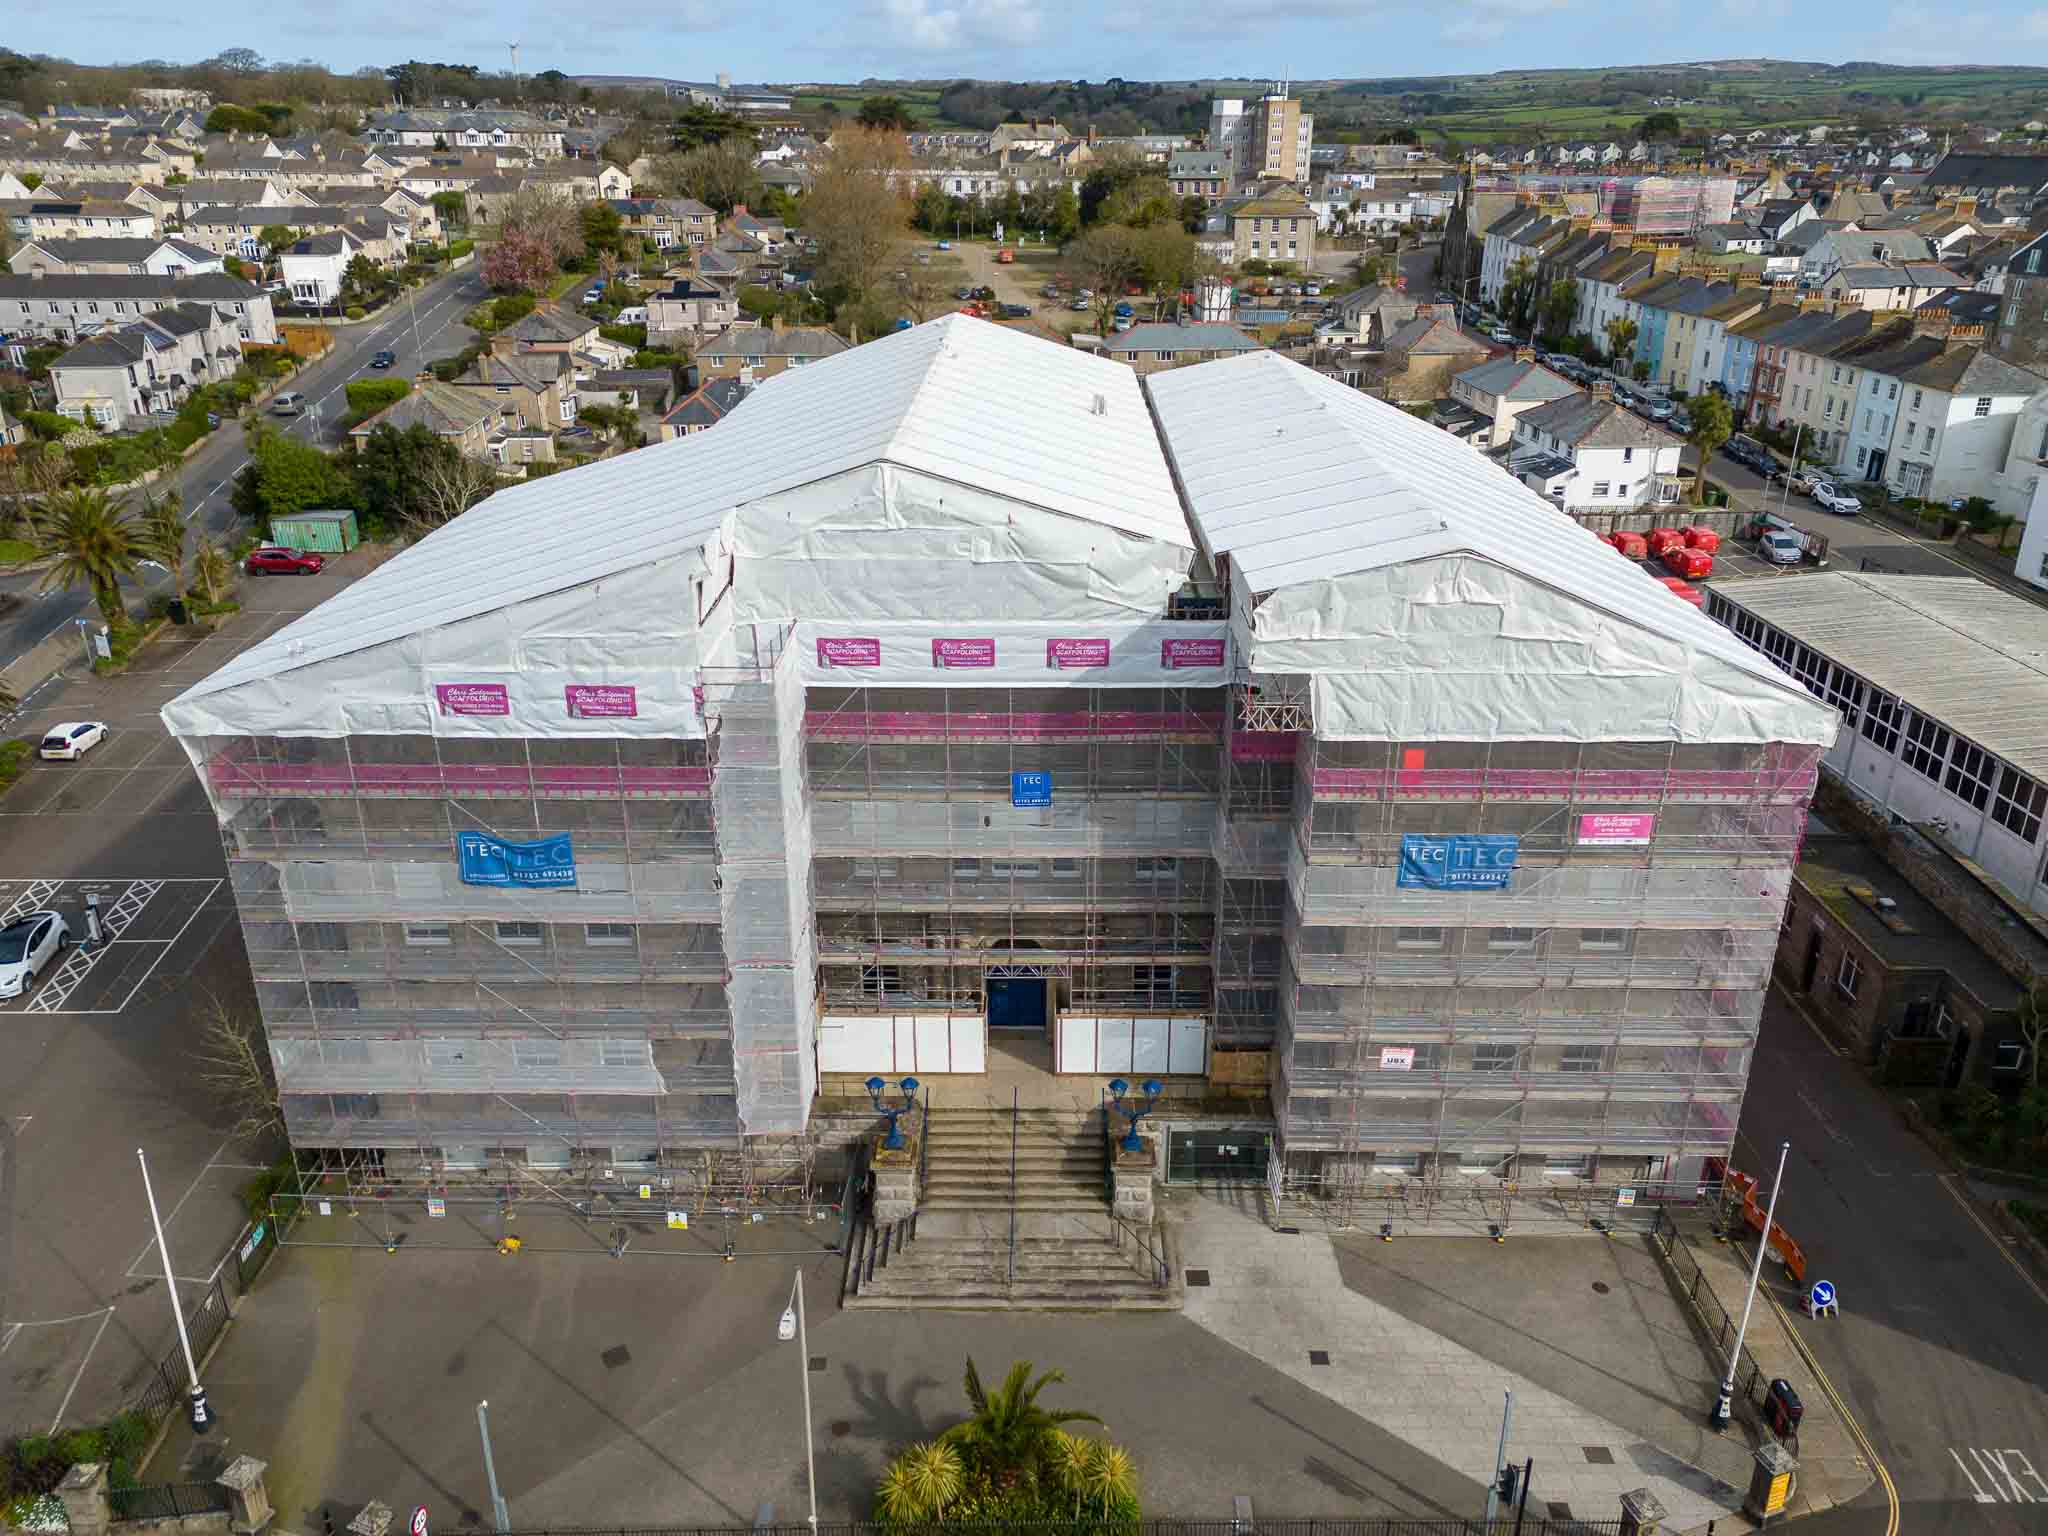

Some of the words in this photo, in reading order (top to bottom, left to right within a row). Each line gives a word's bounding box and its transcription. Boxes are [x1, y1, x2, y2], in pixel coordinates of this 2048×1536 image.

[1023, 776, 1041, 785] TEC
[465, 843, 504, 858] TEC
[513, 844, 570, 866] TEC
[1407, 847, 1445, 861] TEC
[1455, 848, 1512, 867] TEC
